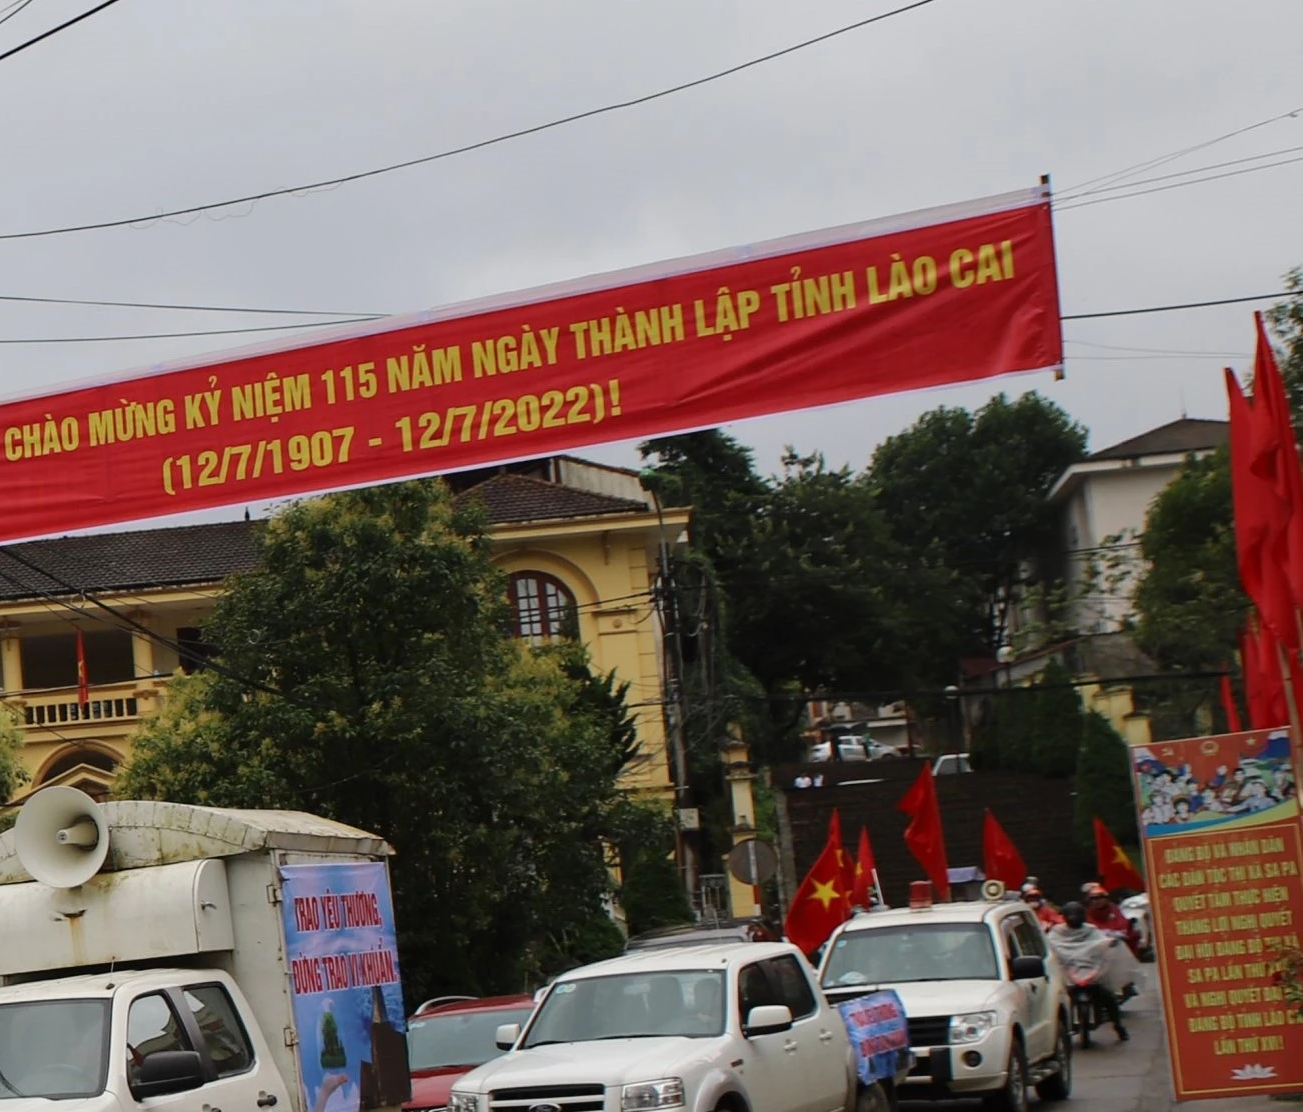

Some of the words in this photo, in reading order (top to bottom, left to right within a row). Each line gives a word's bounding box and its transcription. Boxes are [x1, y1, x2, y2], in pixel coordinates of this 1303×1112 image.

[4, 414, 79, 461] CHÀO
[89, 399, 176, 446] MỪNG
[186, 375, 222, 430] KỶ
[232, 366, 311, 423] NIỆM
[321, 361, 377, 404] 115
[387, 345, 461, 393] NĂM
[472, 323, 559, 379] NGÀY
[570, 307, 684, 360] THÀNH
[695, 286, 760, 341] LẬP
[771, 266, 856, 323] TỈNH
[867, 254, 937, 305] LÀO
[950, 240, 1015, 288] CAI
[163, 426, 355, 495] (12/7/1907
[369, 436, 382, 448] -
[294, 897, 321, 932] TRAO
[320, 888, 341, 930] YÊU
[322, 955, 349, 991] TRAO
